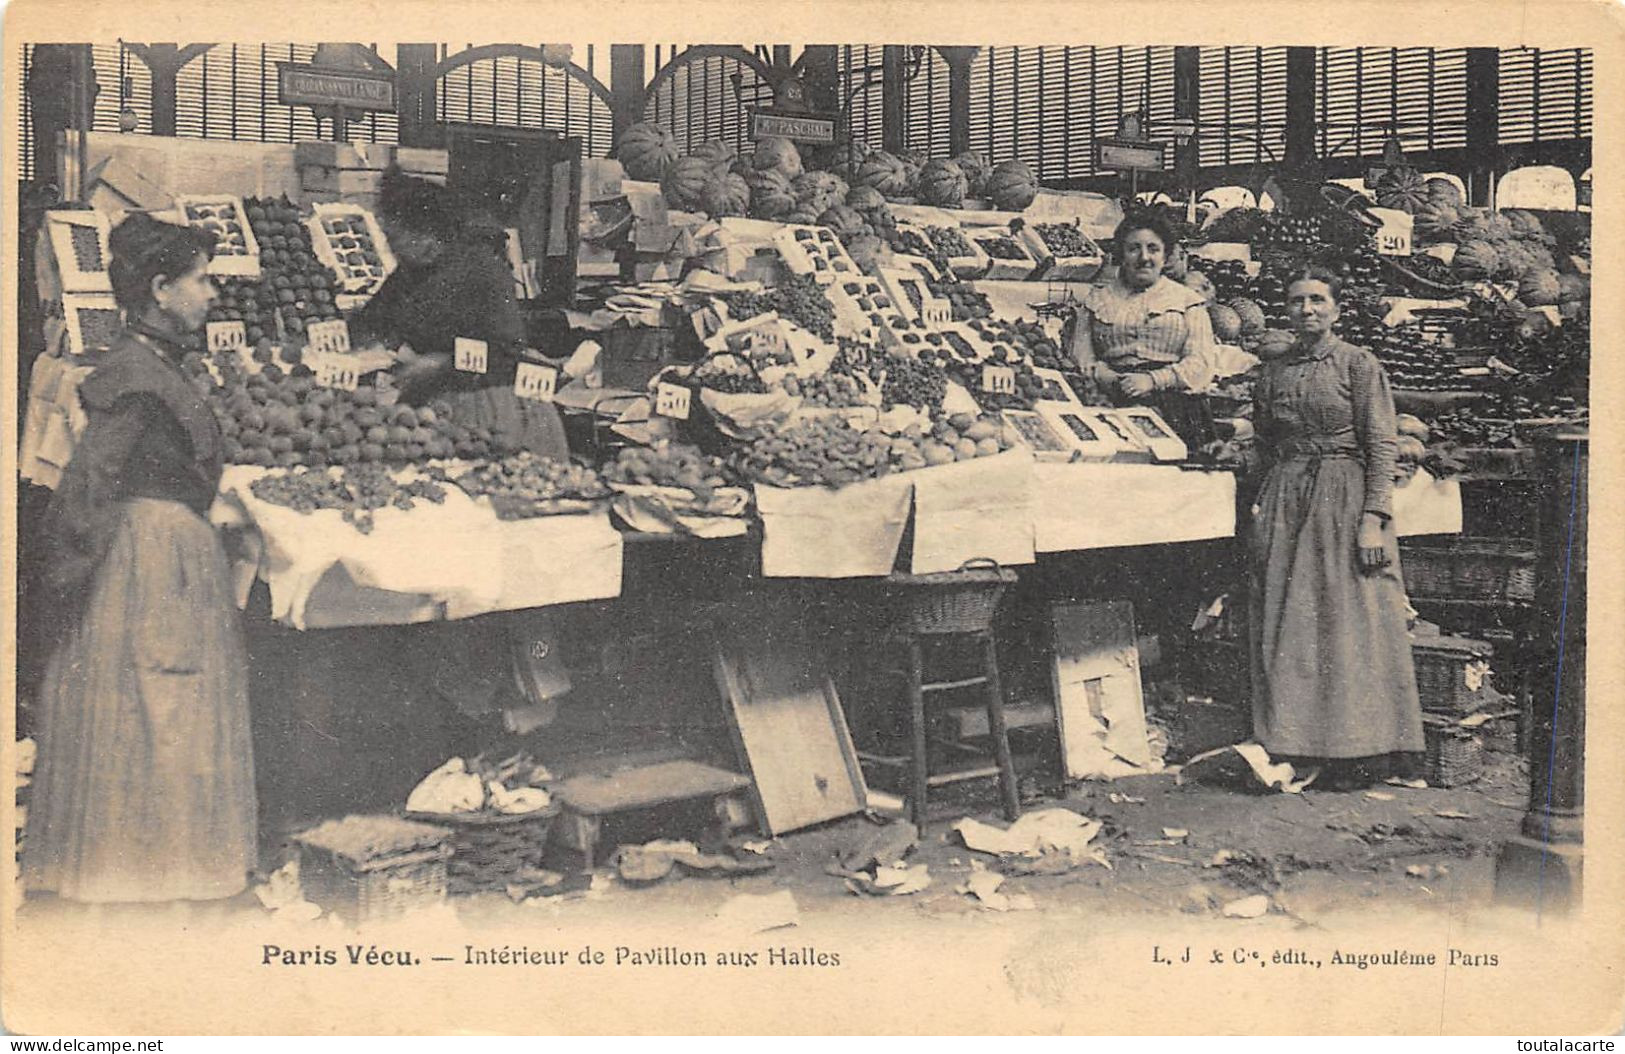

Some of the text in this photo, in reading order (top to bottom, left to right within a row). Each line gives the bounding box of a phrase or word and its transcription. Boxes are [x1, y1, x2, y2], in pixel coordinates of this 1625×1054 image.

[1383, 236, 1405, 250] 20
[927, 309, 950, 323] 60
[214, 332, 243, 350] 60
[460, 351, 484, 371] 40
[522, 374, 551, 396] 60
